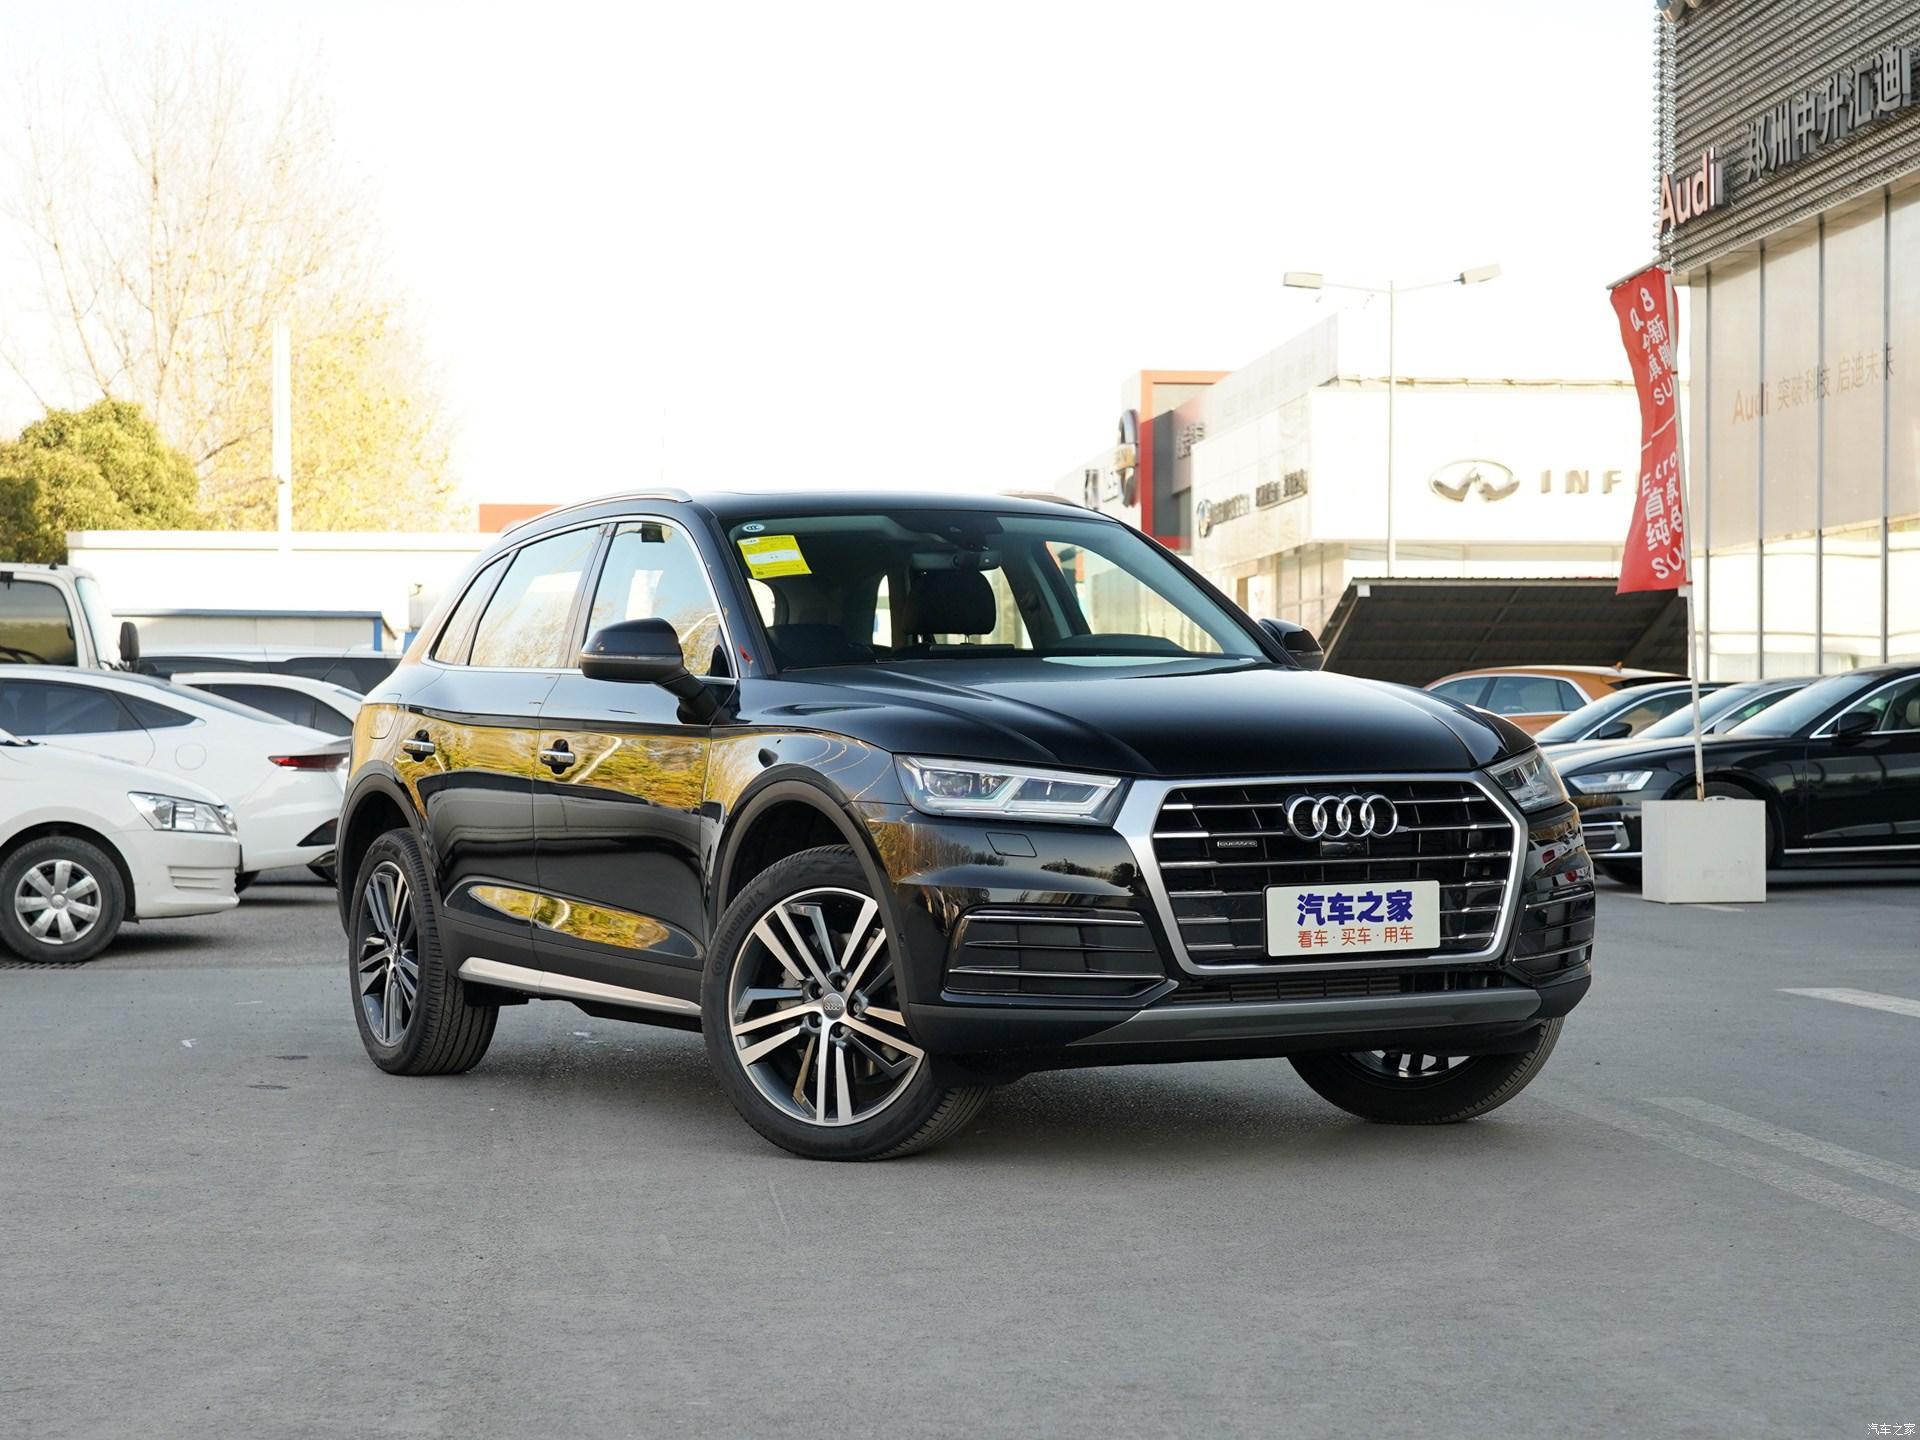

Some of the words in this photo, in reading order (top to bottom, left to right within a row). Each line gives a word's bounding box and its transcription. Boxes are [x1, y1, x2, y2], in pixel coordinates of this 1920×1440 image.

[1746, 46, 1904, 182] 郑州中升汇迪
[1659, 145, 1715, 233] Audi
[1653, 376, 1674, 406] SU
[1732, 382, 1769, 424] Audi
[1297, 889, 1413, 926] 汽车之家
